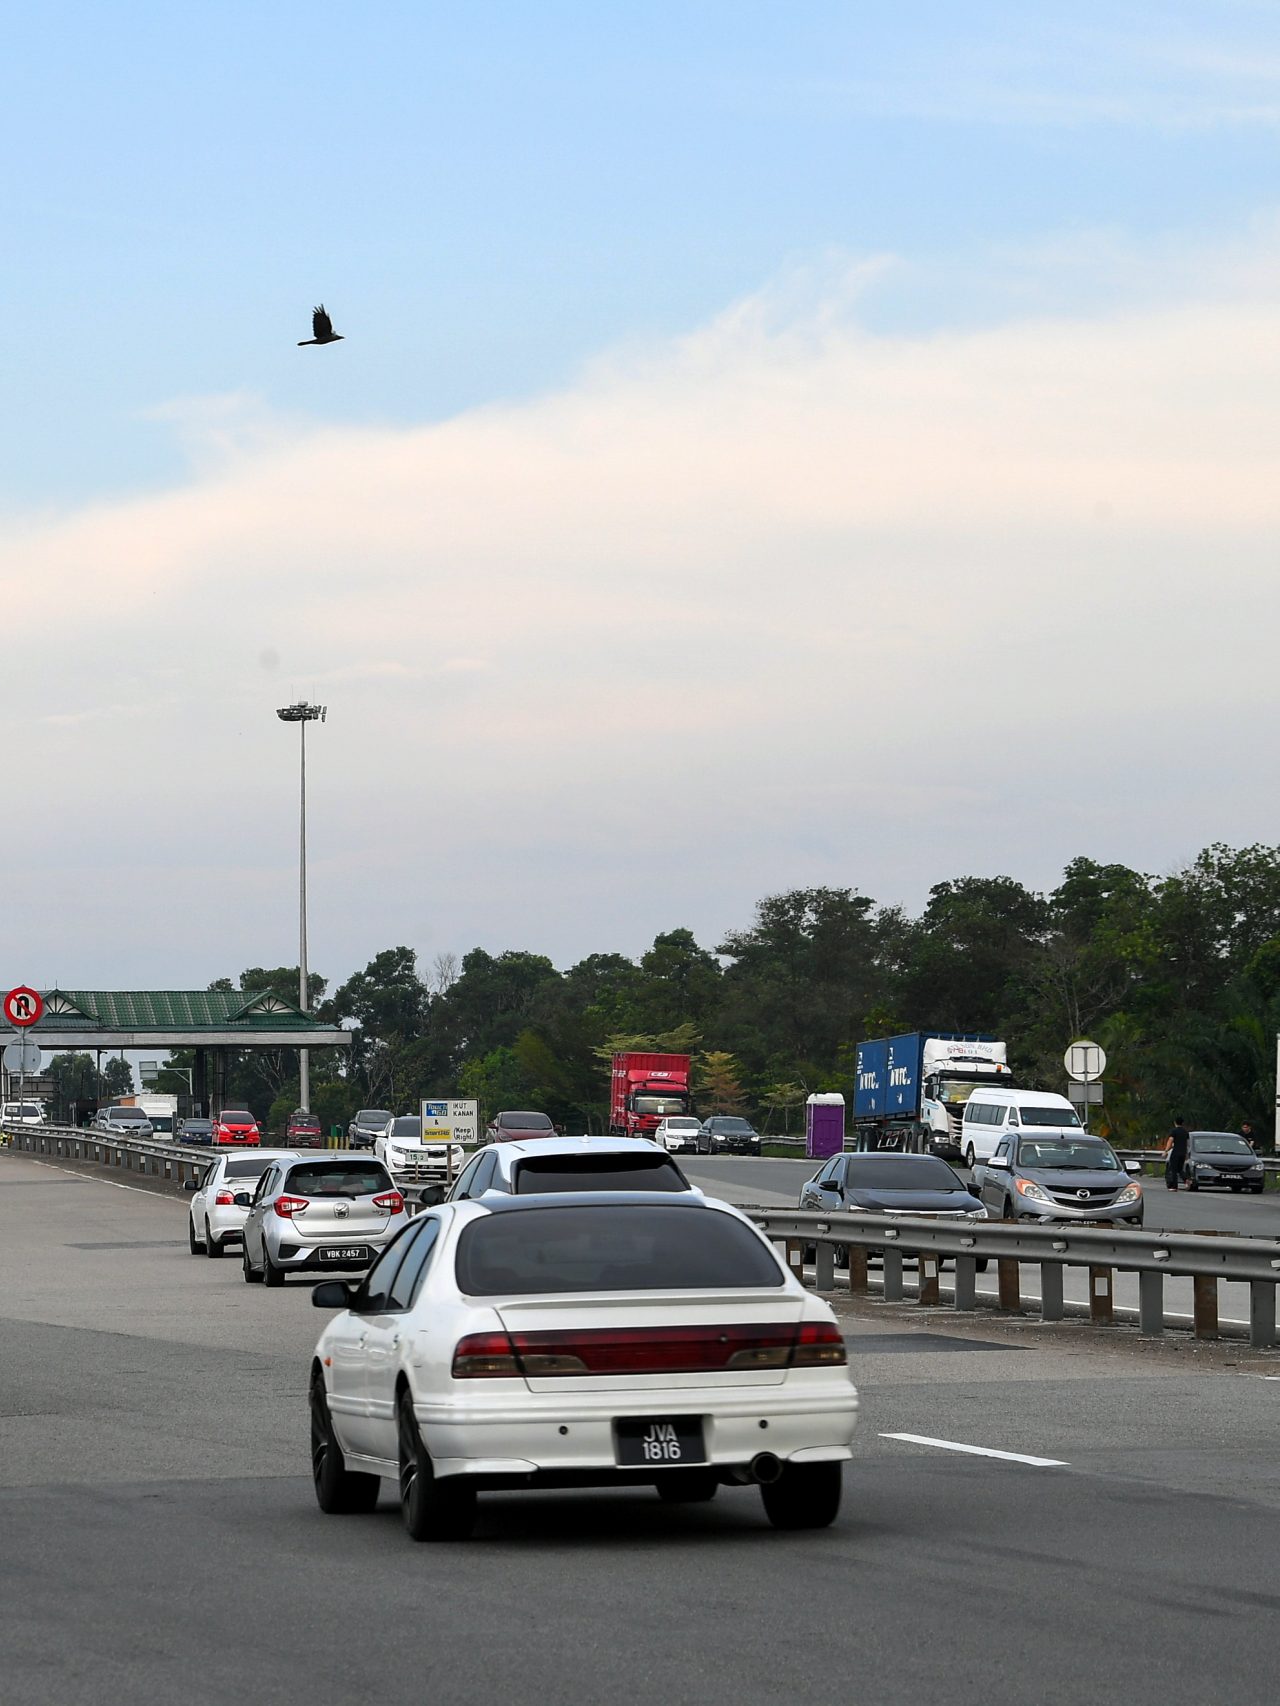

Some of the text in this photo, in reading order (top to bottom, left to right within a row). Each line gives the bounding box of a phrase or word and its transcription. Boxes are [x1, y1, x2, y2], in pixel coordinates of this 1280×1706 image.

[326, 1250, 360, 1258] VBK 2457
[644, 1424, 678, 1442] JVA
[642, 1441, 682, 1460] 1816
